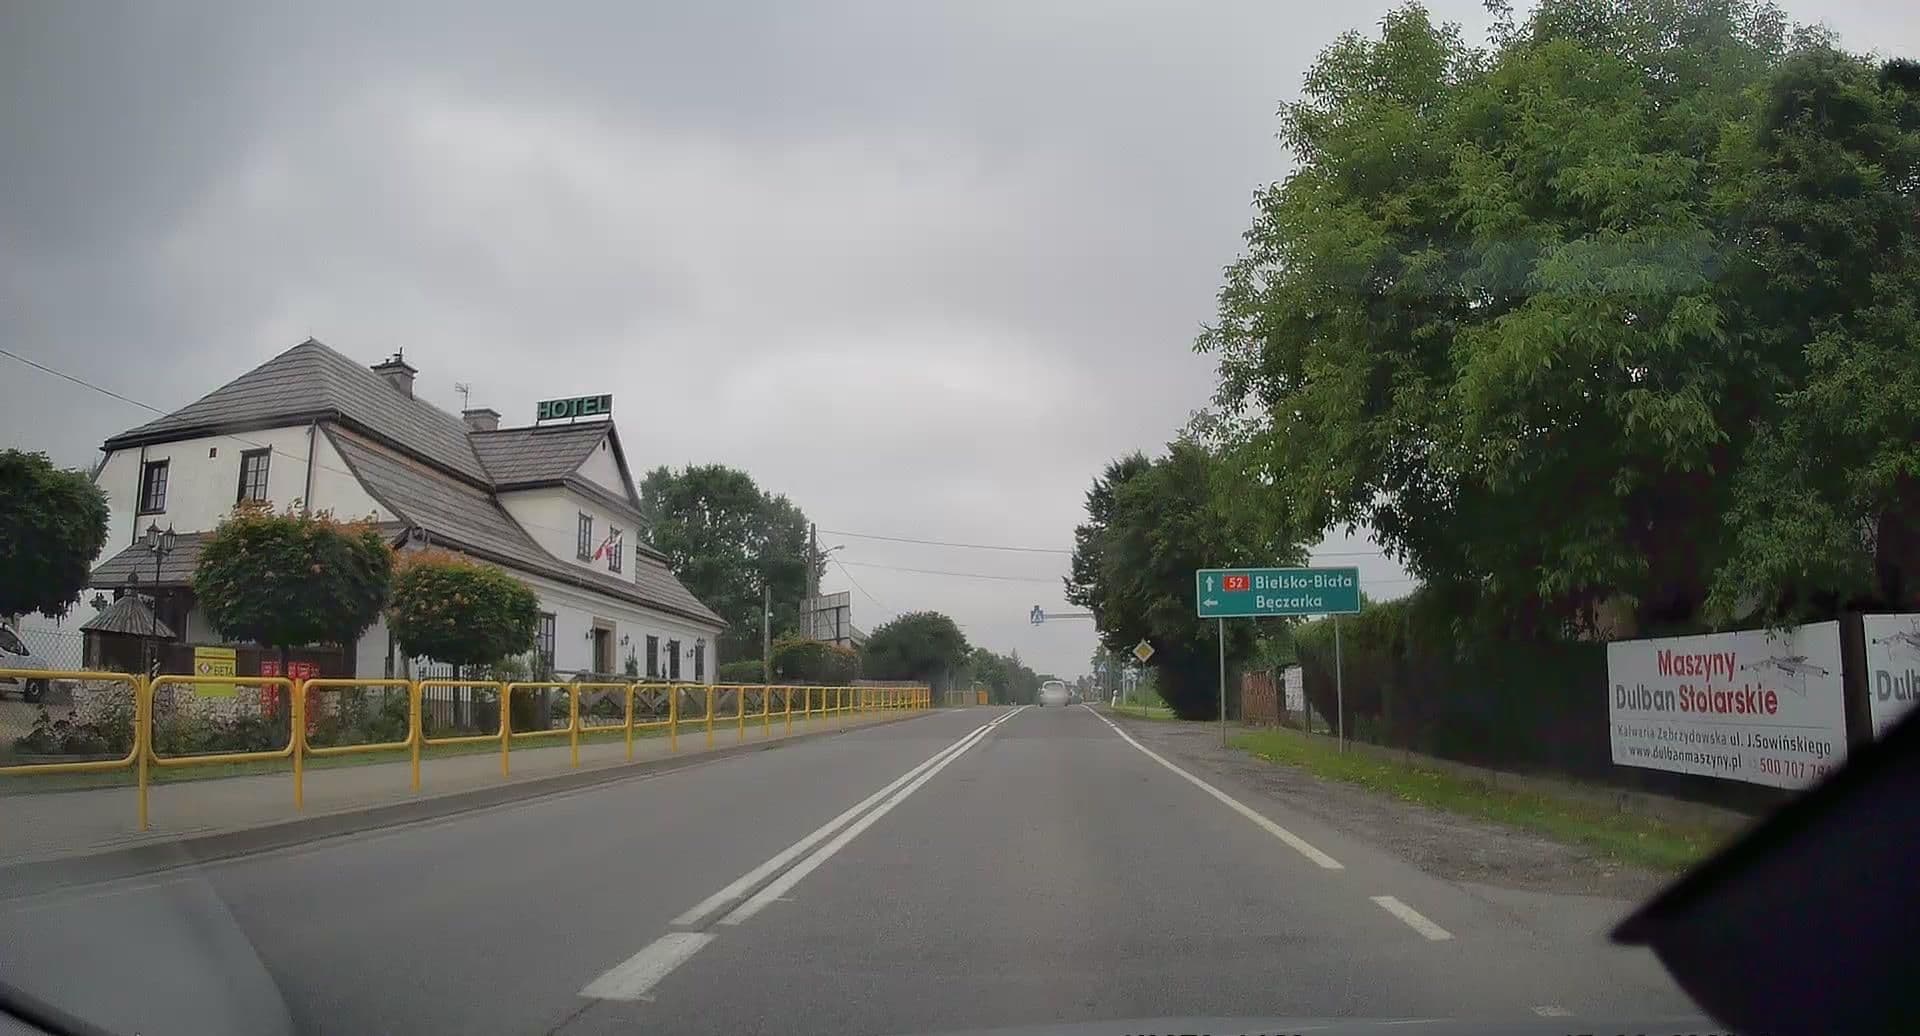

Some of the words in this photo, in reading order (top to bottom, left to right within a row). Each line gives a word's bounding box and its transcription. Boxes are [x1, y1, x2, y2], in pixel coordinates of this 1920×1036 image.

[538, 396, 610, 418] HOTEL
[1229, 577, 1243, 588] 52
[1255, 575, 1352, 589] Bielsko-Biała
[1256, 595, 1322, 612] Bęczarka
[1657, 649, 1736, 682] Maszyny
[1616, 684, 1676, 711] Dulban
[1679, 682, 1778, 714] Stolarskie
[1657, 727, 1727, 746] Zebrzydowska
[1729, 731, 1744, 747] ul.
[1628, 745, 1742, 772] www.dulbanmaszyny.pl
[1760, 758, 1781, 775] 500
[1784, 760, 1805, 778] 707
